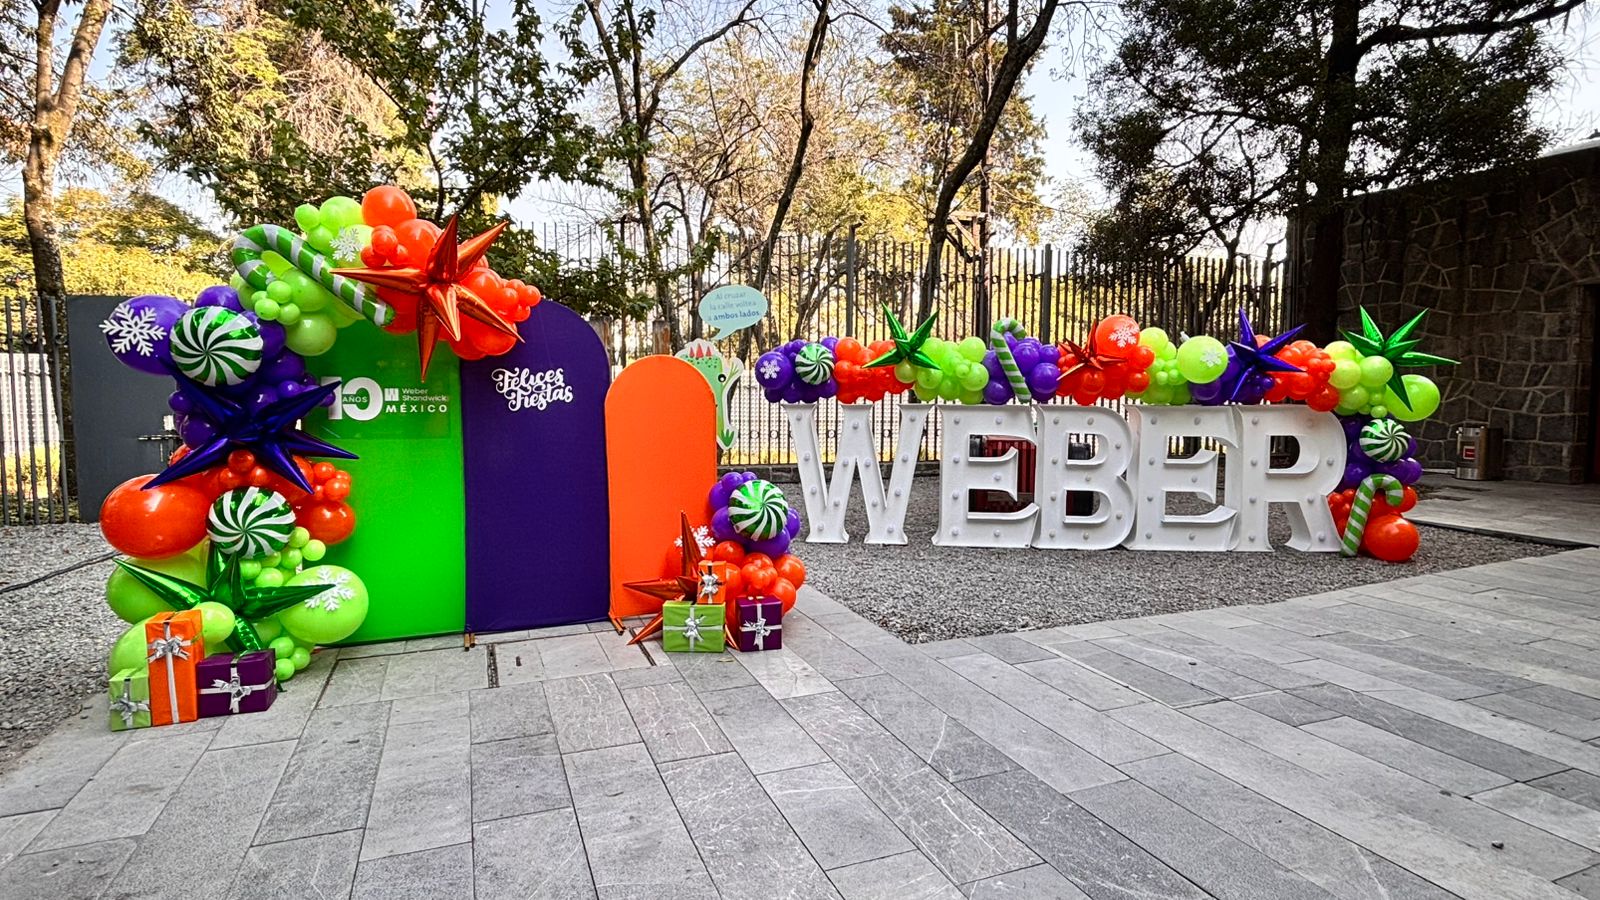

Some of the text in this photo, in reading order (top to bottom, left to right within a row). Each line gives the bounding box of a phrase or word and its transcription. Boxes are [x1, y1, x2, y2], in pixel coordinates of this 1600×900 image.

[714, 312, 738, 320] ambos
[491, 366, 565, 394] Felices
[321, 376, 383, 421] 10
[342, 394, 368, 403] AÑOS
[385, 403, 448, 413] MÉXICO
[504, 383, 574, 412] Fiestas
[784, 404, 1346, 551] WEBER
